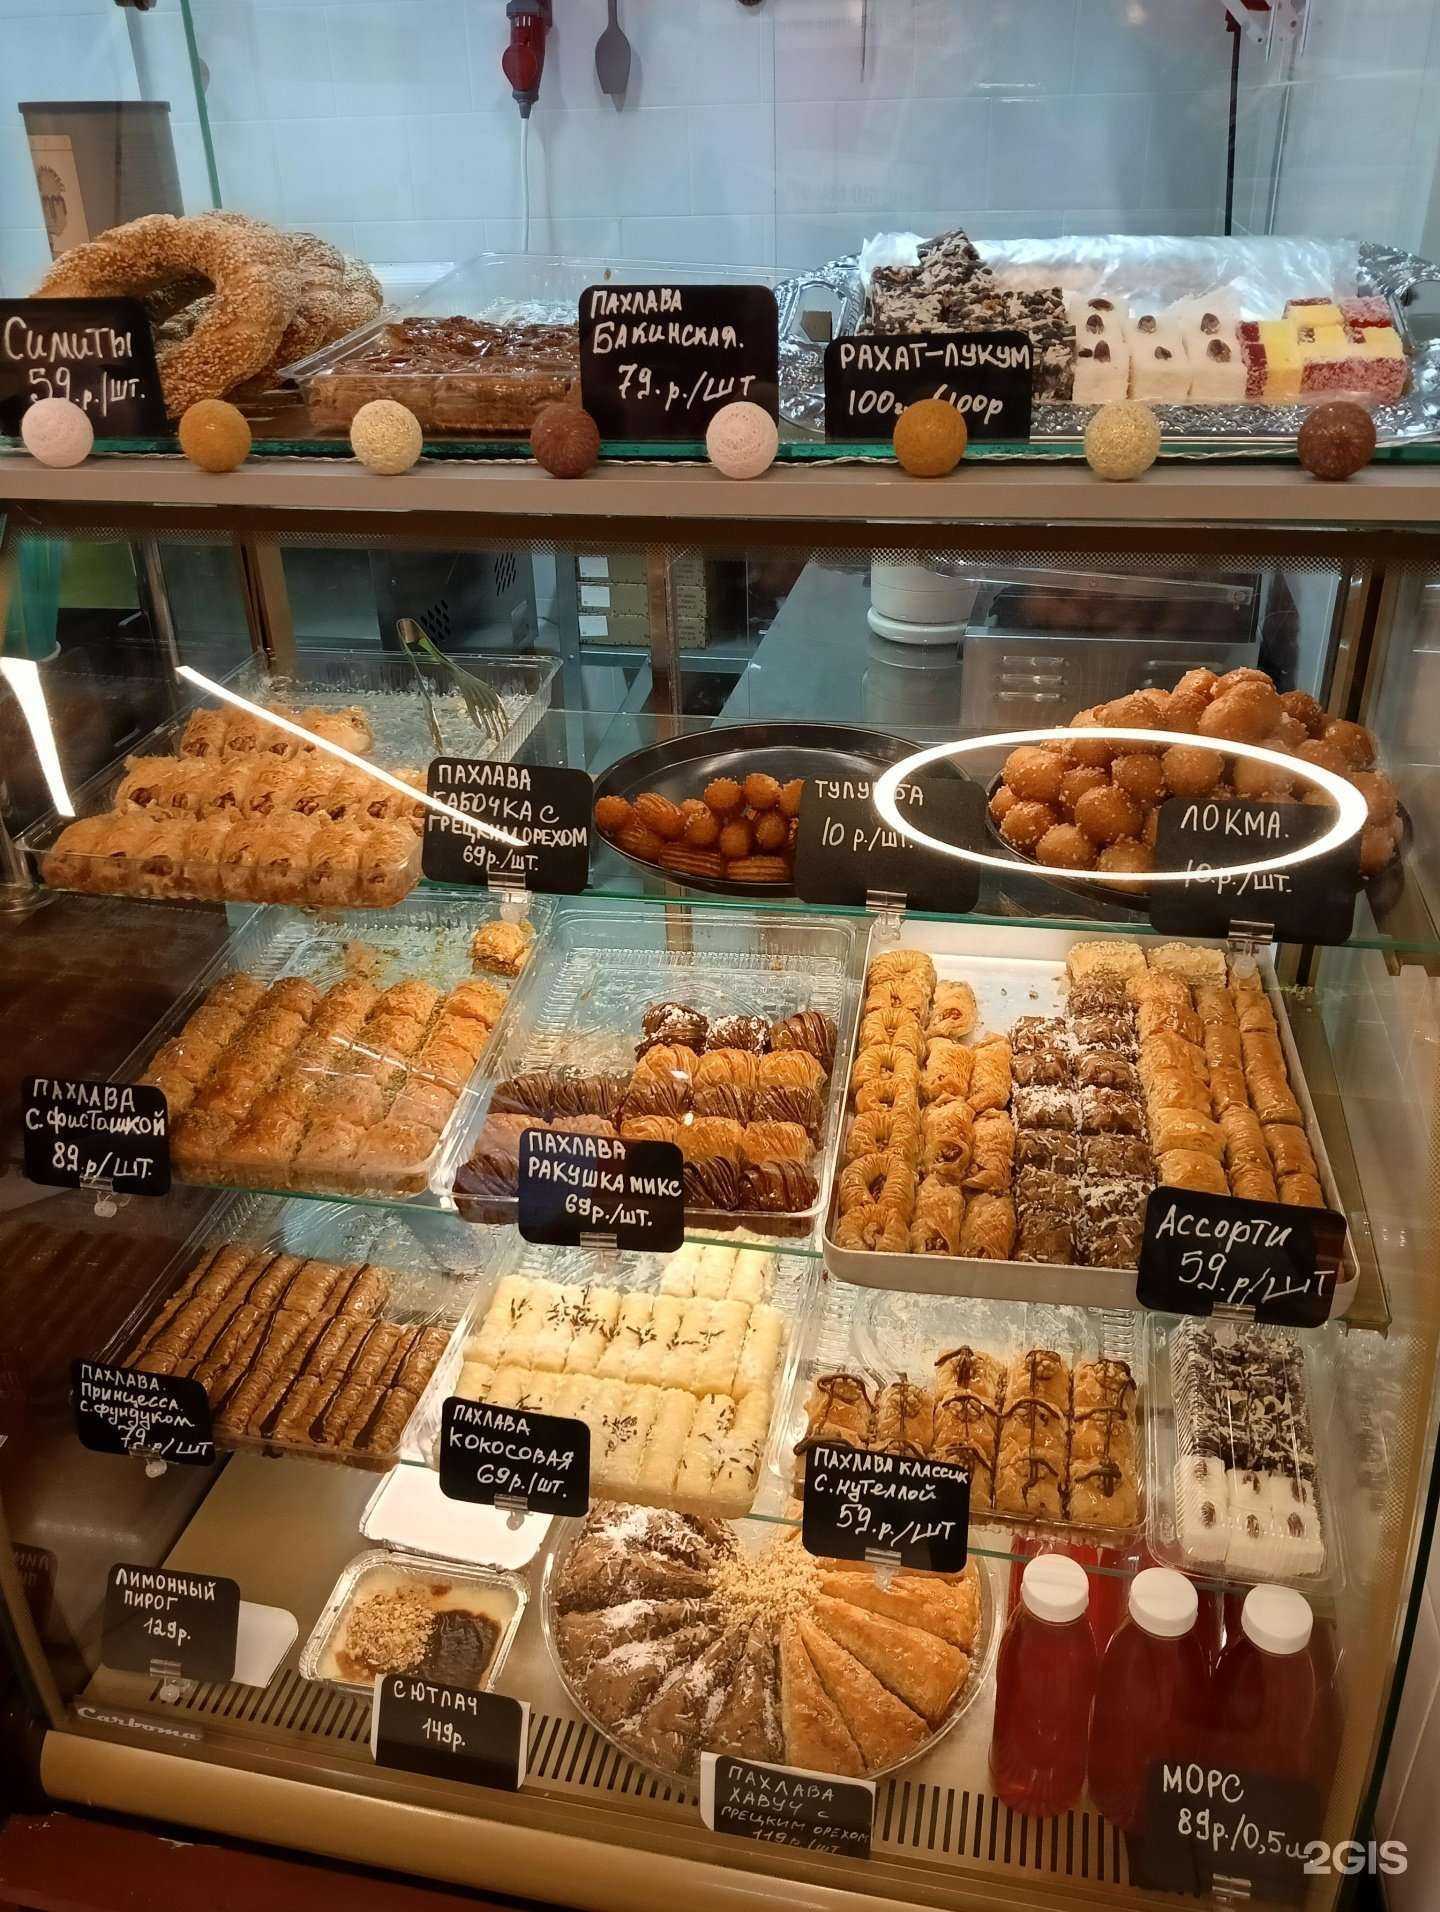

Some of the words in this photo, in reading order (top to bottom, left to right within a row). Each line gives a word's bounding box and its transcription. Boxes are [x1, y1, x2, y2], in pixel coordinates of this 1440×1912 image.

[590, 288, 683, 319] ПАХЛАВА
[4, 316, 132, 362] Симиты
[840, 343, 1030, 372] РАХАТ-ЛУКУМ
[438, 764, 531, 792] ПАХЛАВА
[815, 779, 924, 806] ТУЛУБА
[522, 827, 588, 848] ОРЕХОМ
[33, 1079, 135, 1113] ПАХЛАВА
[528, 1131, 627, 1160] ПАХЛАВА
[528, 1156, 624, 1193] РАКУШКА
[630, 1175, 682, 1197] МИКС
[1155, 1203, 1293, 1253] Ассорти
[453, 1404, 531, 1436] ПАХЛАВА
[814, 1446, 893, 1473] ПАХЛАВА
[115, 1567, 216, 1601] ЛИМОННЫЙ
[124, 1590, 178, 1611] ПИРОГ
[144, 1616, 191, 1647] 129р.
[394, 1680, 477, 1716] СЮТЛАЧ
[77, 1706, 203, 1742] Carboma
[422, 1717, 466, 1753] 149р.
[728, 1765, 835, 1801] ПАХЛАВА
[1163, 1763, 1244, 1803] МОРС
[729, 1787, 804, 1815] ХАВУЧ
[813, 1826, 870, 1844] ОРЕХОМ
